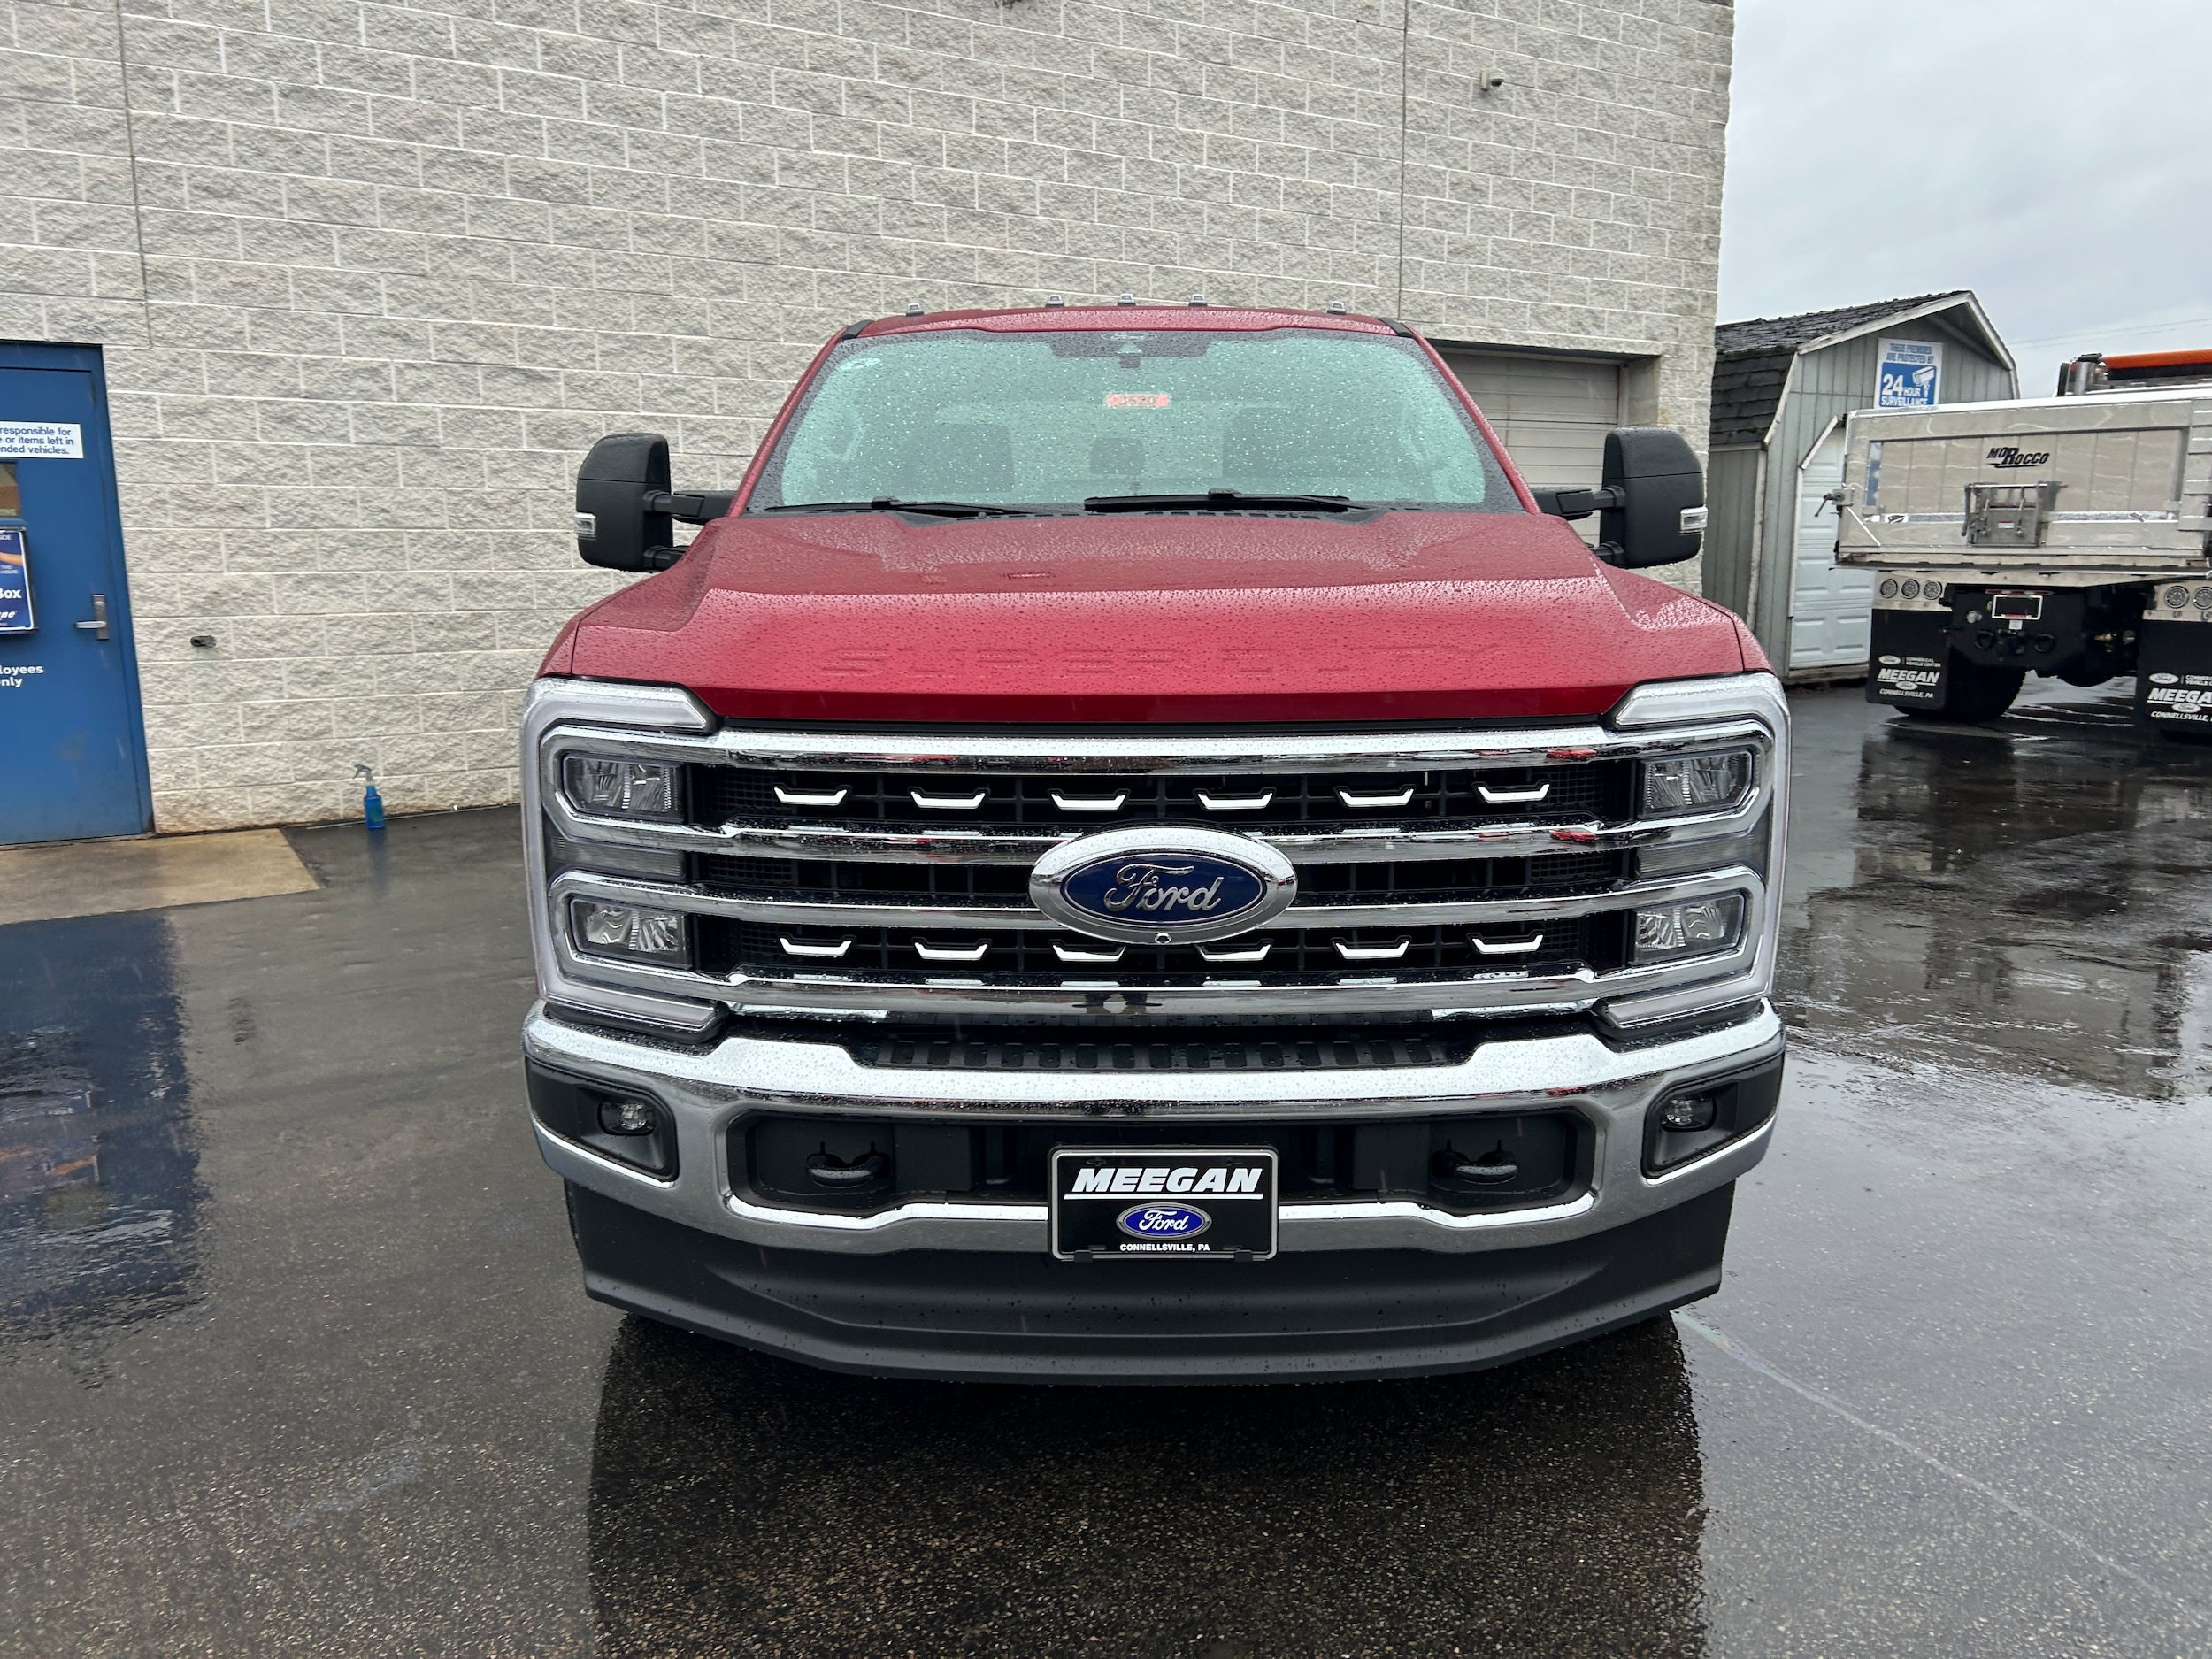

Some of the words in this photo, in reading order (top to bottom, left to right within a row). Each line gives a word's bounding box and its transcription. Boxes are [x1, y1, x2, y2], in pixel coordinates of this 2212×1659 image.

[1881, 373, 1904, 396] 24
[1903, 387, 1921, 397] HOUR
[1881, 396, 1929, 406] SURVEILLANCE
[18, 435, 45, 444] items
[47, 436, 63, 445] left
[27, 445, 70, 454] vehicles.
[1878, 668, 1940, 683] MEEGAN
[0, 677, 23, 687] nly
[1104, 863, 1225, 912] Ford
[1071, 1167, 1263, 1193] MEEGAN
[1138, 1210, 1188, 1231] Ford
[1119, 1243, 1195, 1252] CONNELLSVILLE,
